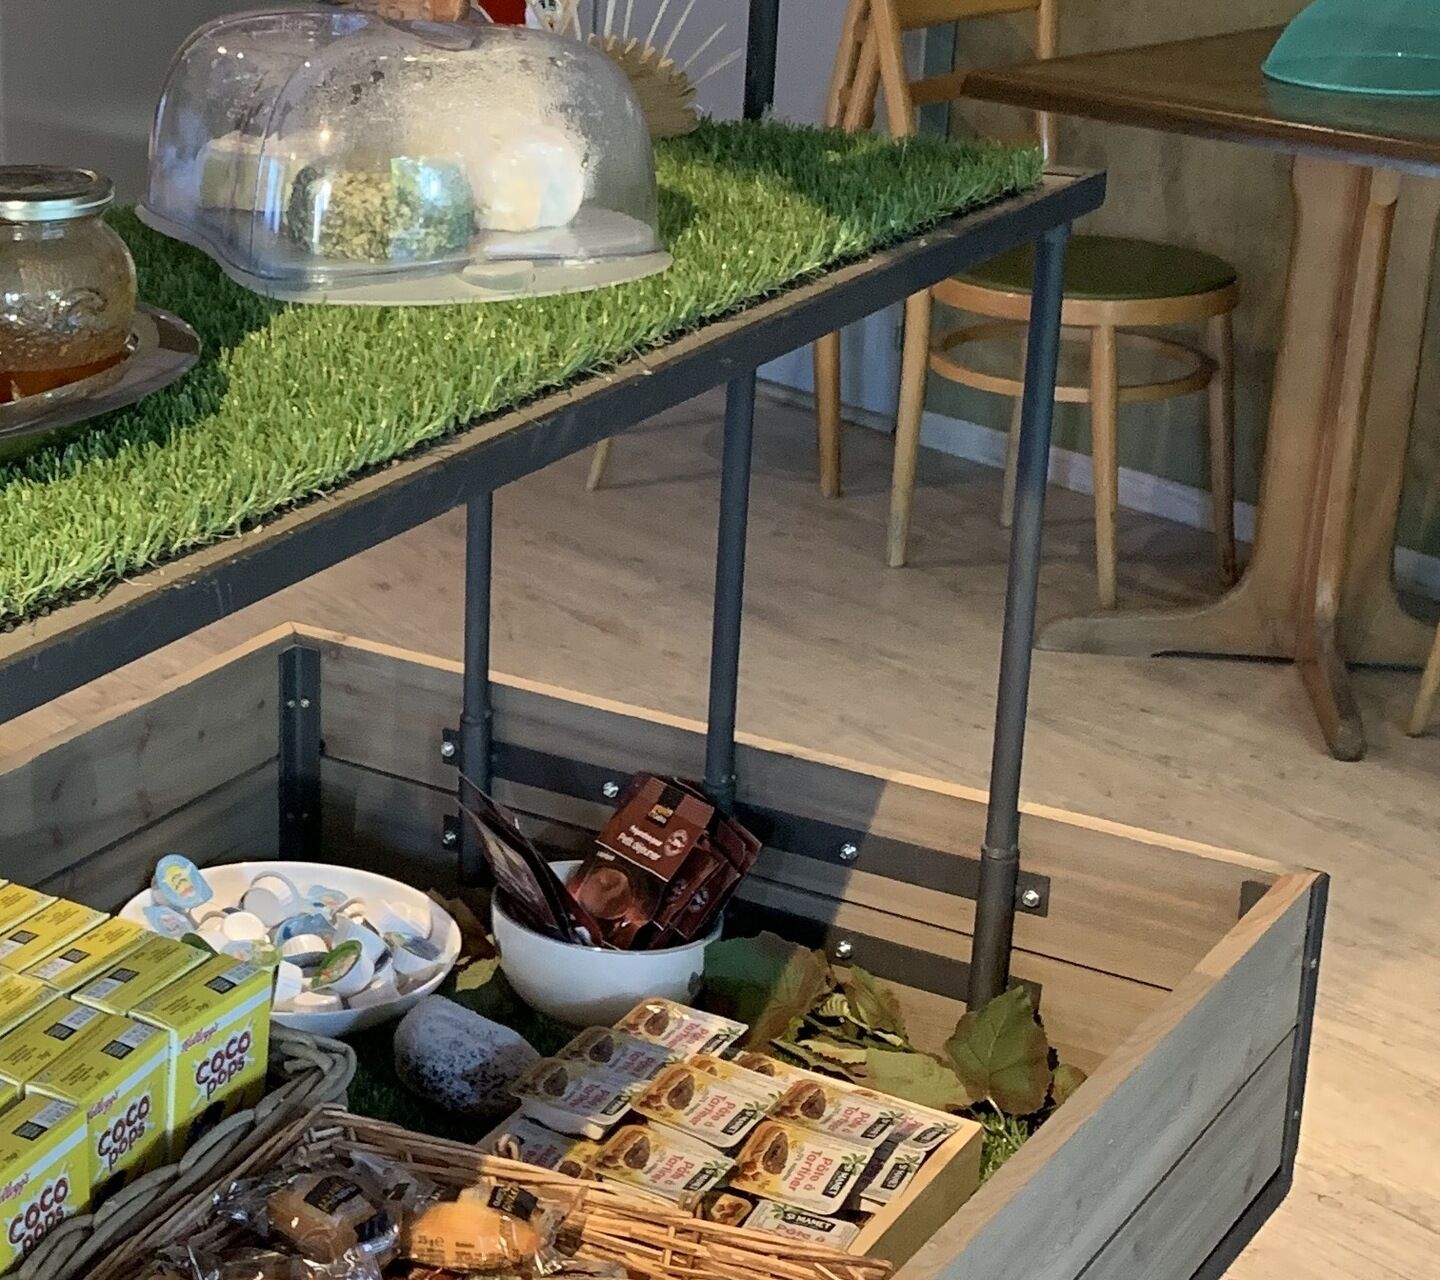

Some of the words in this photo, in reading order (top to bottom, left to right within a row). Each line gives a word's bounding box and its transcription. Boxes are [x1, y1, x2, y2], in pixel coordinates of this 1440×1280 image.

[196, 1030, 251, 1085] COCO
[206, 1056, 245, 1101] pops
[98, 1095, 150, 1157] COCO
[108, 1121, 145, 1172] pops
[788, 1150, 824, 1192] Tartiner
[808, 1156, 834, 1182] Pâte
[8, 1177, 68, 1245] COCO
[795, 1213, 833, 1230] MAMET
